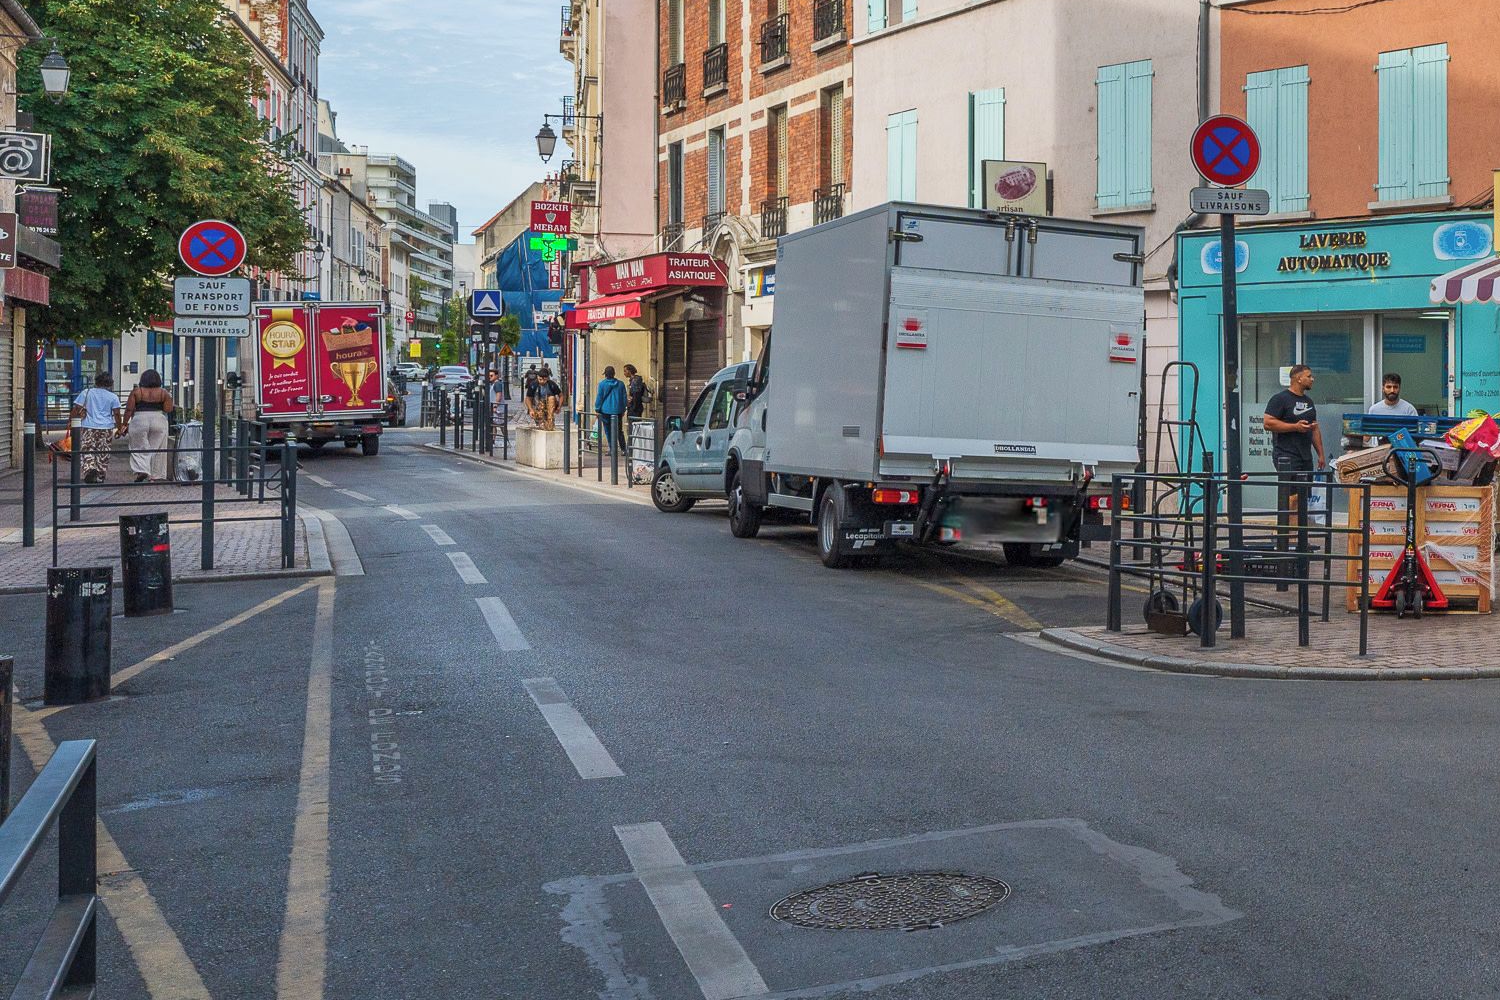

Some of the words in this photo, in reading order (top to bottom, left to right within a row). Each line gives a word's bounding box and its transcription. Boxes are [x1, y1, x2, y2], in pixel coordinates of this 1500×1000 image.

[1217, 192, 1244, 200] SAUF
[534, 202, 569, 211] BOZKIR
[996, 205, 1024, 213] artisan
[1200, 202, 1262, 211] LIVRAISONS
[533, 223, 567, 232] MERAM
[1299, 231, 1368, 250] LAVERIE
[668, 257, 710, 268] TRAITEUR
[1277, 252, 1391, 273] AUTOMATIQUE
[668, 270, 716, 280] ASIATIQUE
[198, 282, 227, 290] SAUF
[181, 292, 244, 300] TRANSPORT
[185, 303, 199, 311] DE
[204, 303, 240, 311] FONDS
[271, 340, 296, 348] STAR
[995, 445, 1036, 453] DHOLLANDIA
[845, 532, 885, 540] Lecapitain
